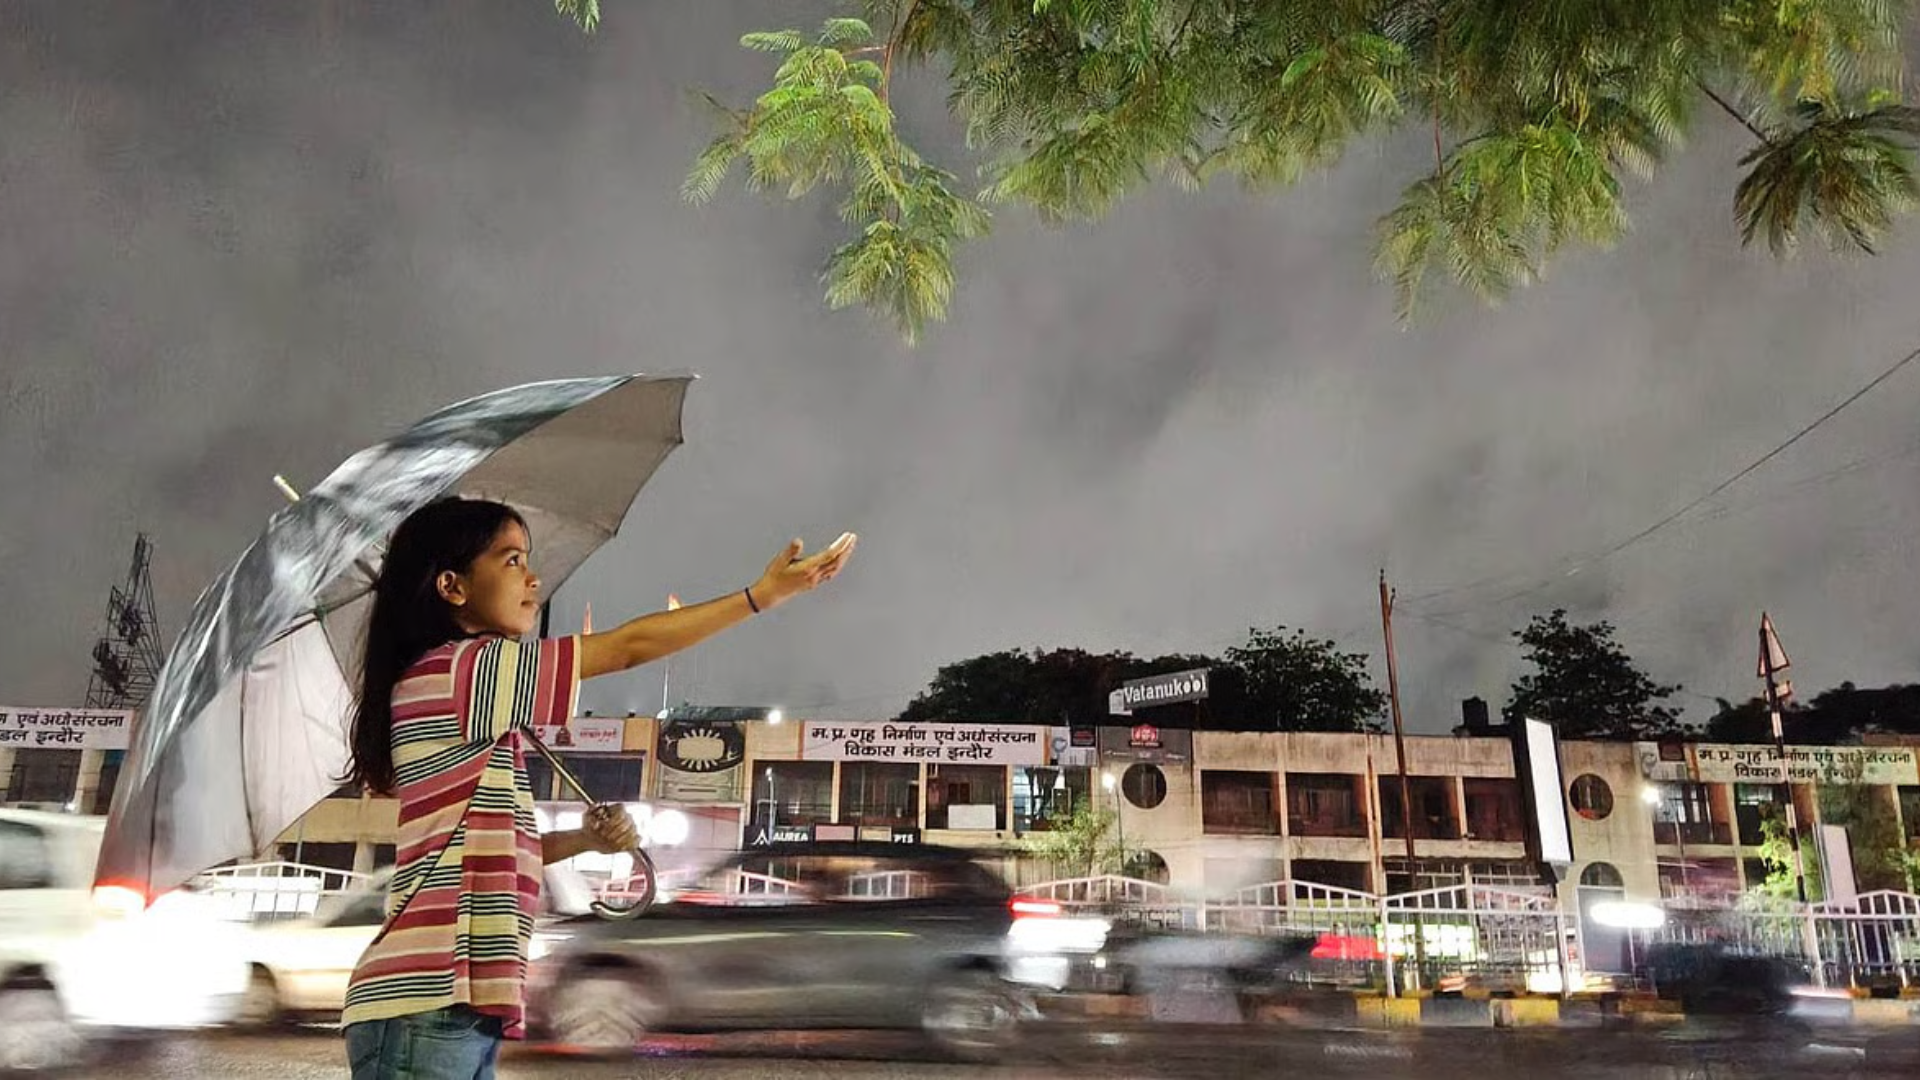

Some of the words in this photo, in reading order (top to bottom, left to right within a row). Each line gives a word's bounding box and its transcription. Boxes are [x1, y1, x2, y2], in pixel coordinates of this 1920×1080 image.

[1123, 673, 1207, 703] Vatanukool
[17, 711, 39, 728] एवं
[883, 725, 926, 741] निर्माण
[934, 726, 955, 745] एवं
[957, 728, 1036, 743] अधोसंरचना
[844, 740, 896, 757] विकास
[903, 742, 941, 758] मंडल
[772, 831, 809, 842] AUREA
